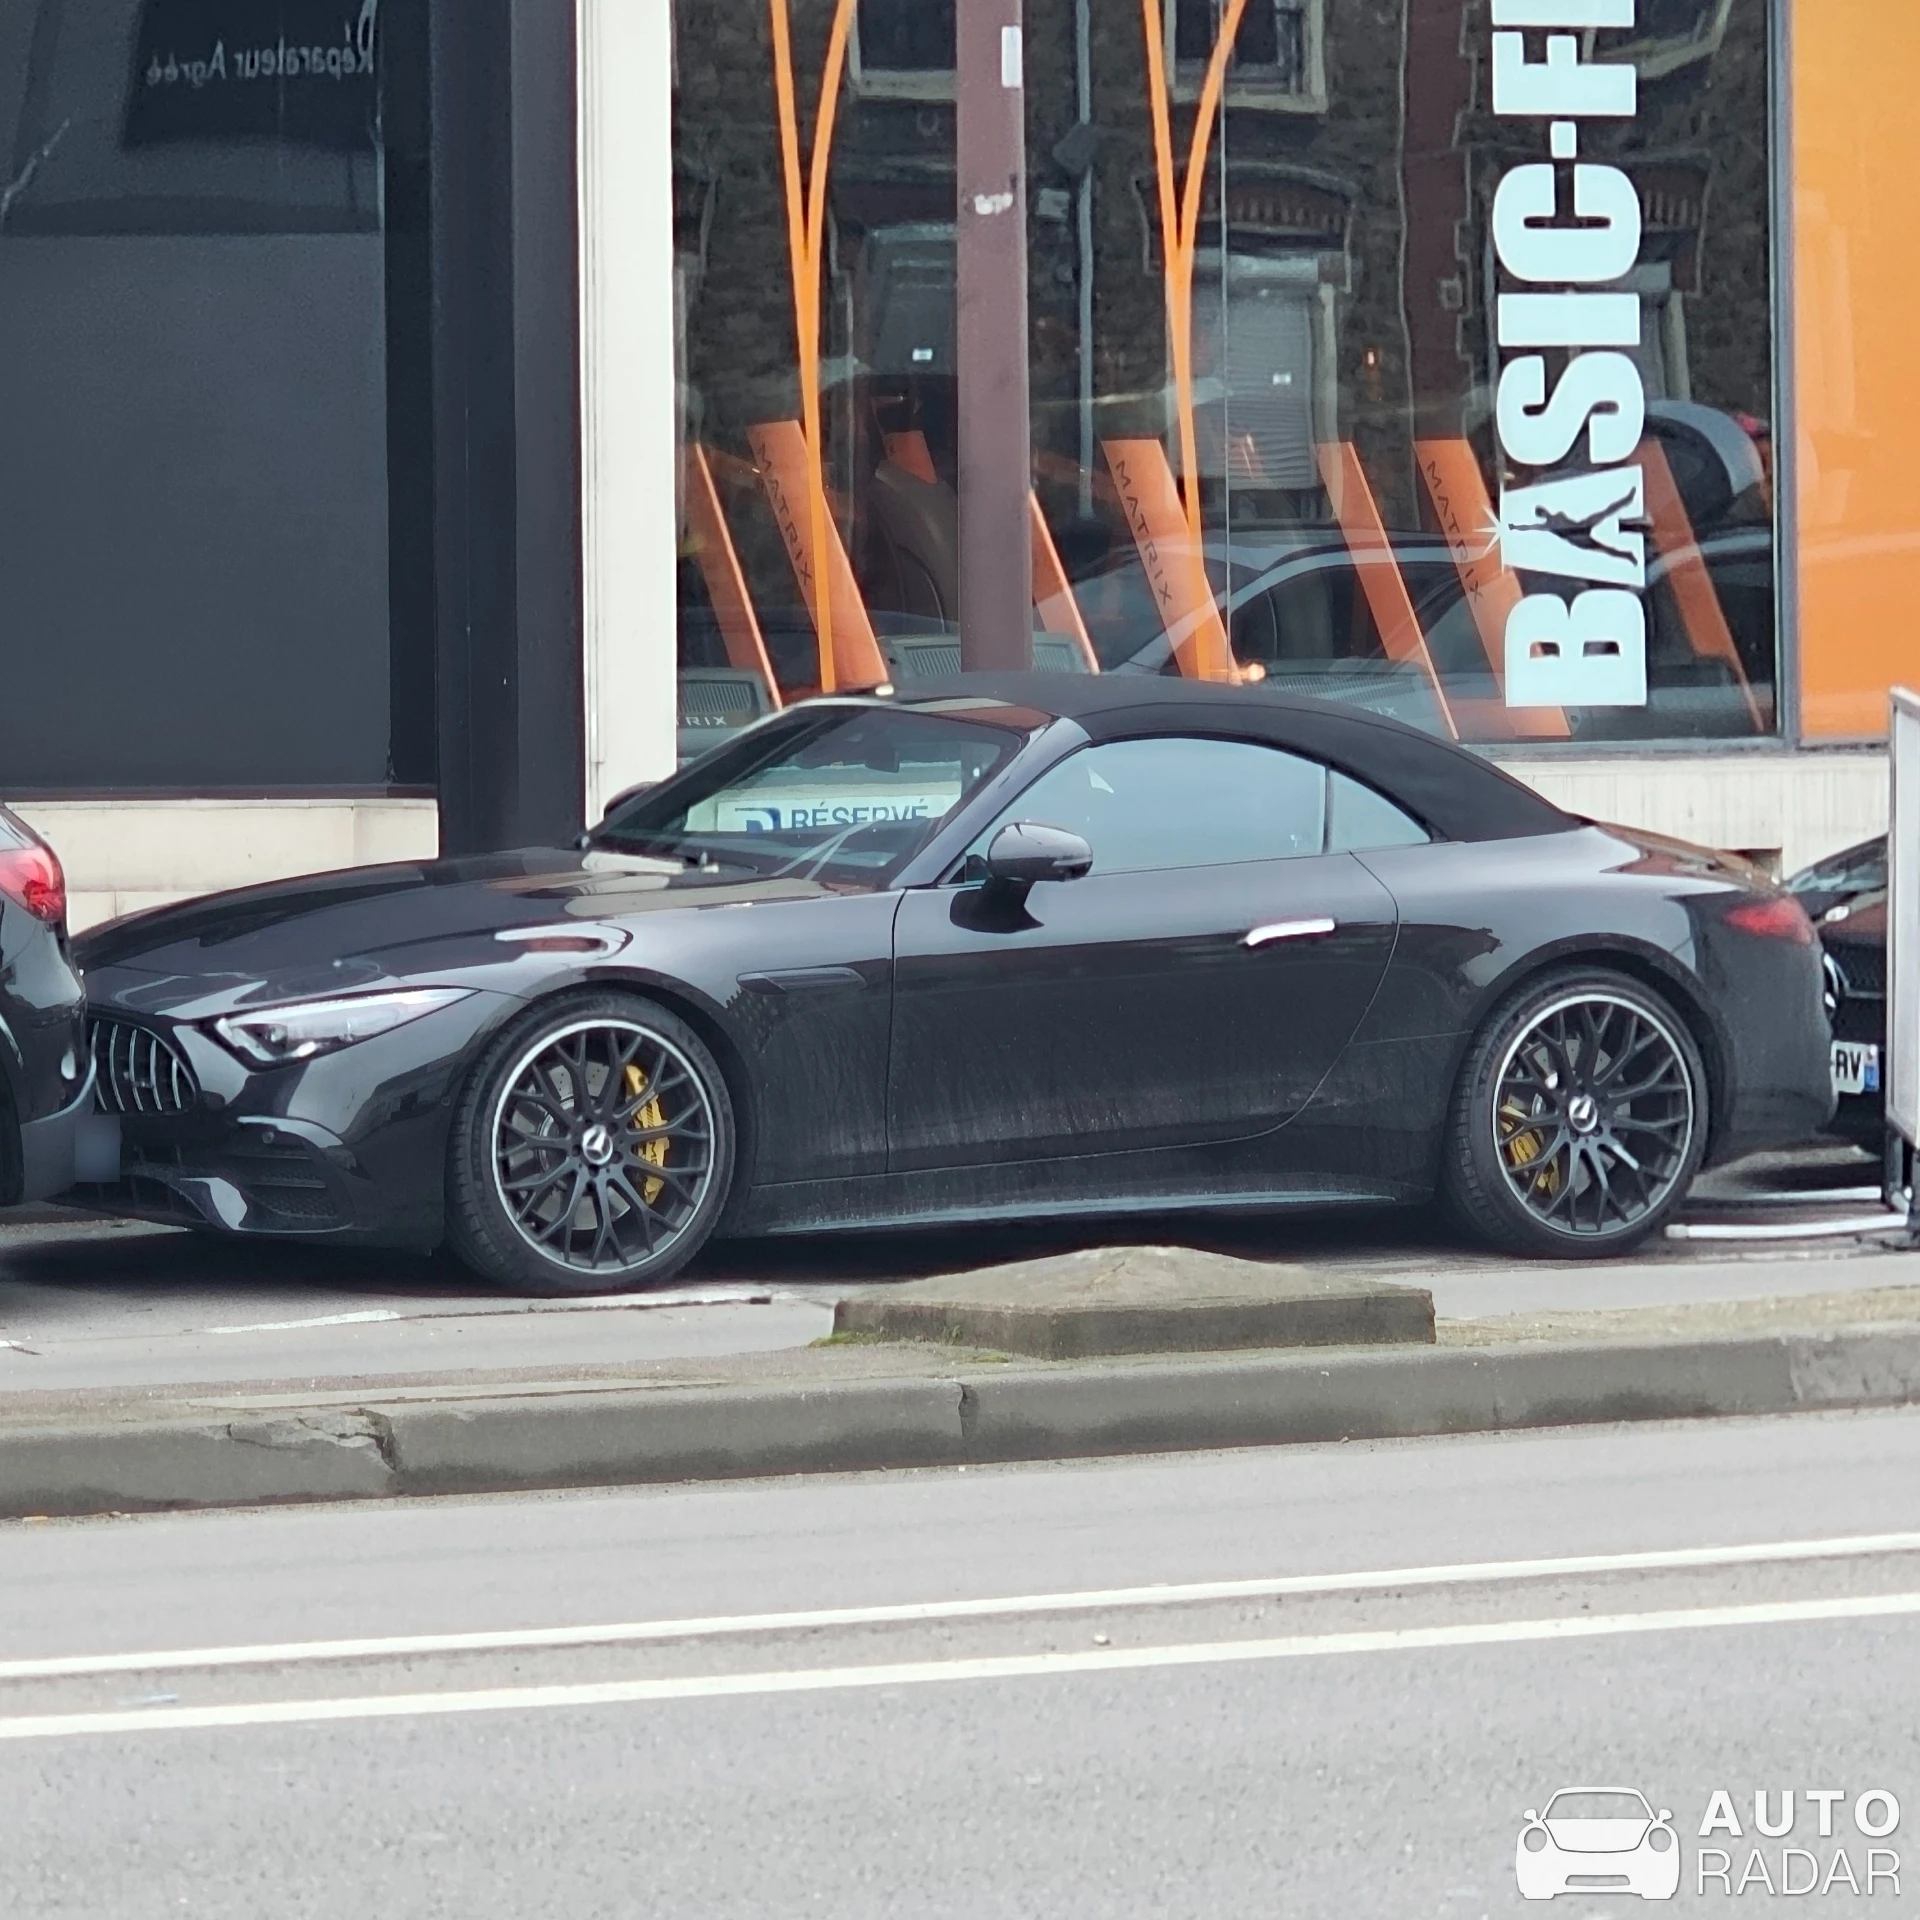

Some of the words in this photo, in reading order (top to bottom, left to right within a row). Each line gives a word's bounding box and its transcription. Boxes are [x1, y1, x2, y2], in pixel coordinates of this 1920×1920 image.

[756, 444, 813, 586] MATRIX
[1115, 460, 1173, 606] MATRIX
[1426, 460, 1484, 604] MATRIX
[677, 715, 728, 726] RIX
[790, 797, 930, 829] RÉSERVÉ
